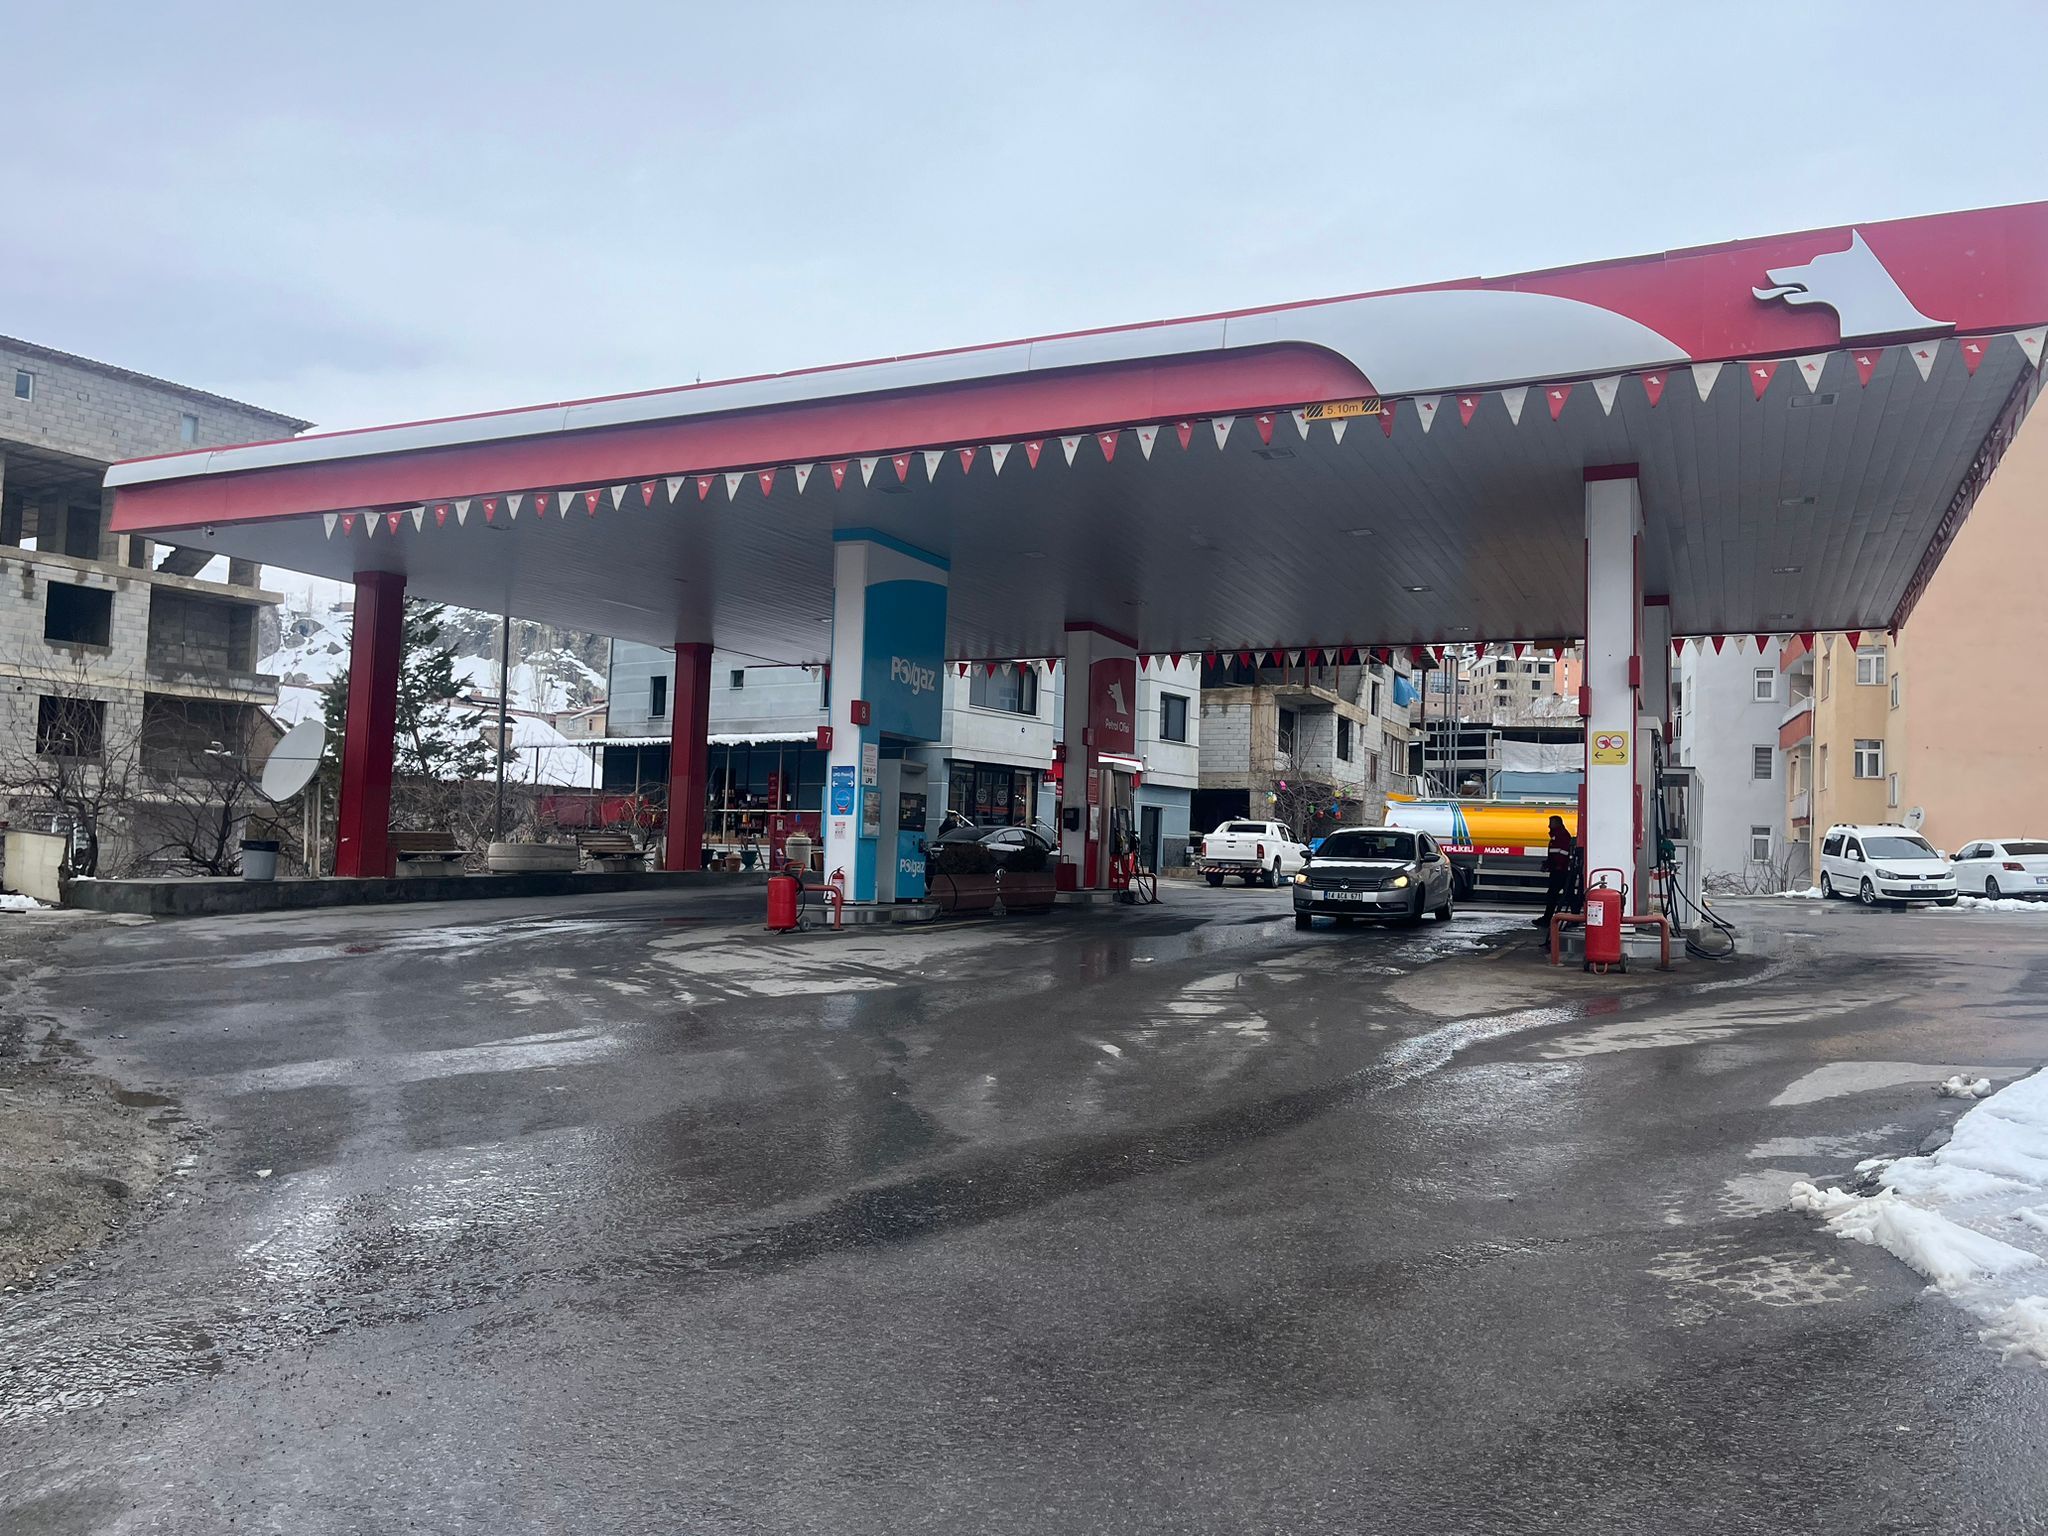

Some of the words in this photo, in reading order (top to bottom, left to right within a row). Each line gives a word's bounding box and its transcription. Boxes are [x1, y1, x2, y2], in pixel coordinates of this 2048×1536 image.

[1327, 403, 1359, 415] 5.10m
[891, 656, 935, 695] Polgaz
[861, 707, 866, 718] 8
[825, 732, 831, 743] 7
